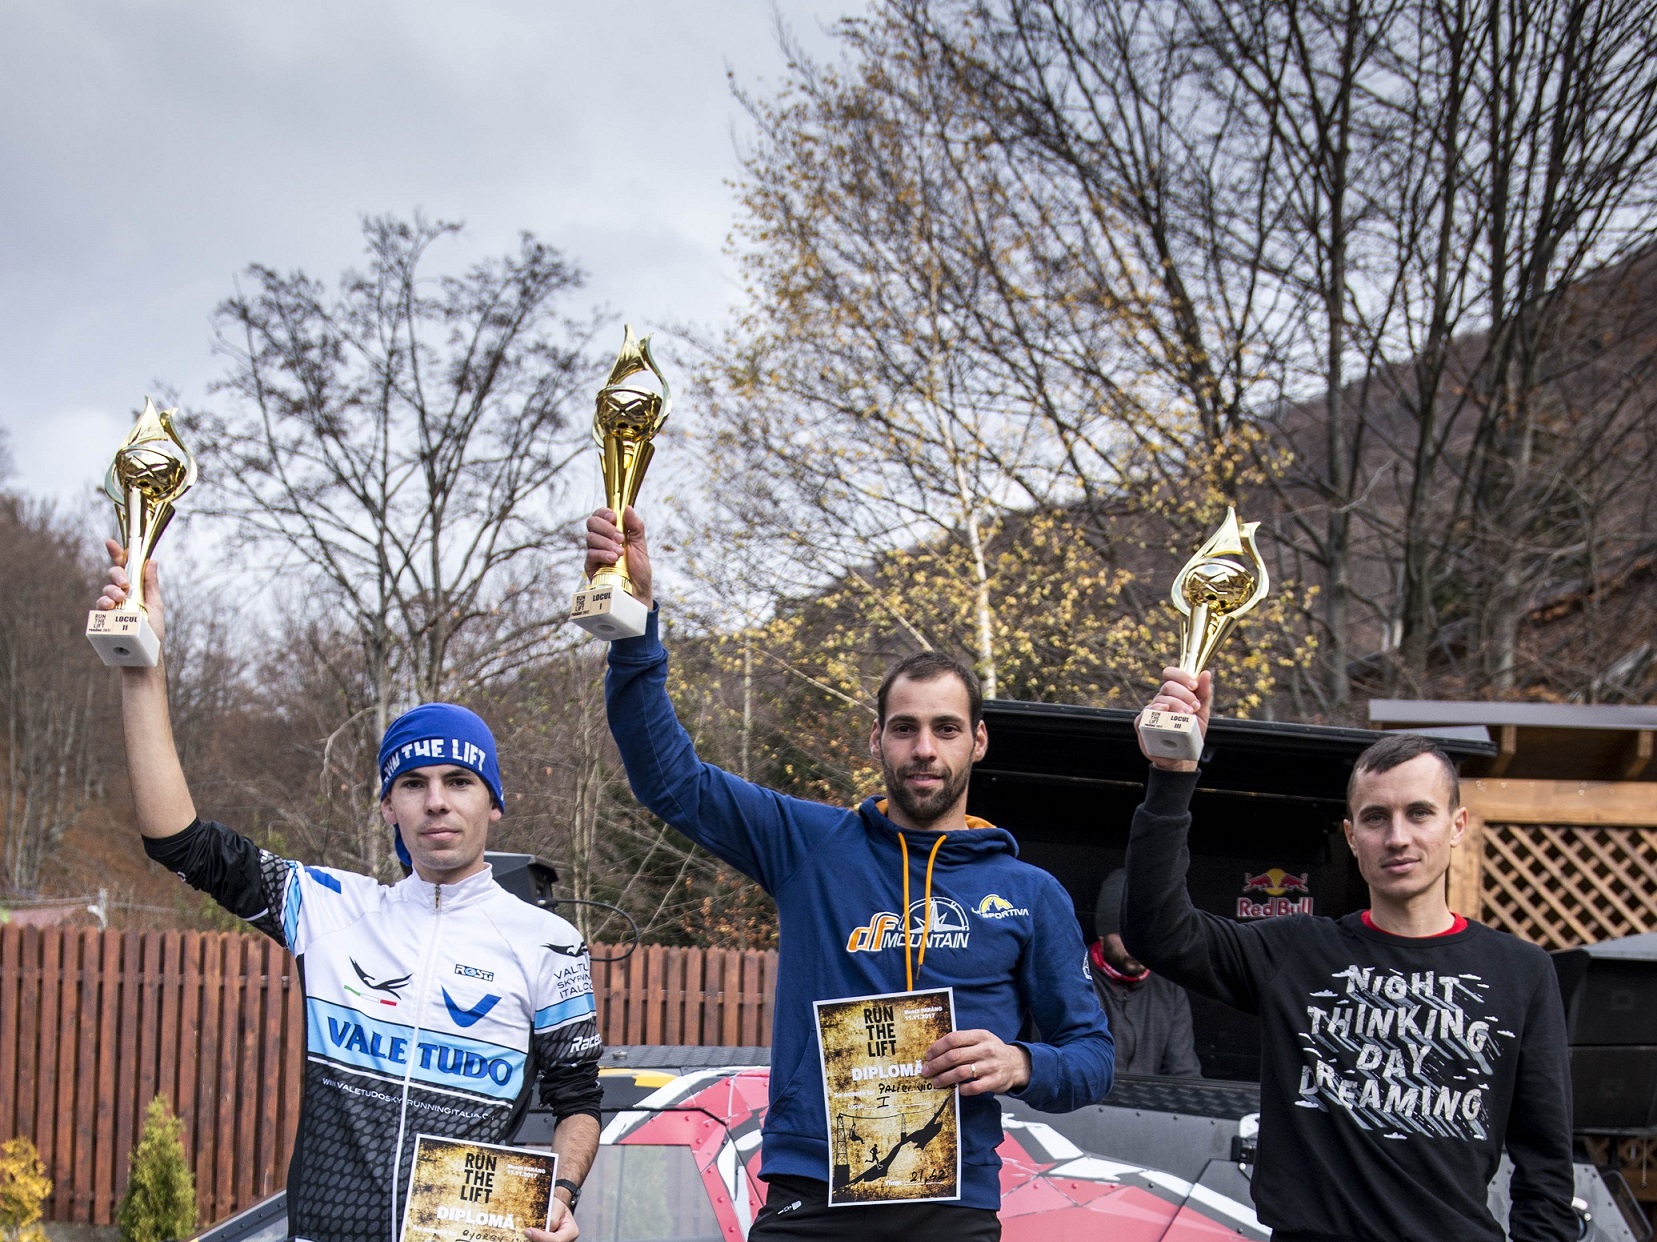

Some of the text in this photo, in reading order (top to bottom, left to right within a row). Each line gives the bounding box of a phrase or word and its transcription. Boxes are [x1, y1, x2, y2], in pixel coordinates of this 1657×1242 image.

[593, 592, 611, 602] LOCUL
[401, 739, 445, 759] THE
[451, 738, 486, 772] LIFT
[981, 908, 1030, 919] SPORTIVA
[1237, 897, 1314, 917] Red Bull
[882, 932, 970, 949] MOUNTAIN
[1346, 964, 1460, 1003] NIGHT
[864, 1006, 894, 1024] RUN
[866, 1023, 896, 1040] THE
[1307, 1003, 1490, 1053] THINKING
[327, 1016, 514, 1087] VALE TUDO
[867, 1040, 896, 1058] LIFT
[1356, 1043, 1432, 1079] DAY
[1298, 1060, 1482, 1122] DREAMING
[465, 1152, 497, 1172] RUN
[464, 1169, 494, 1188] THE
[460, 1186, 492, 1204] LIFT
[436, 1206, 515, 1230] DIPLOMĂ
